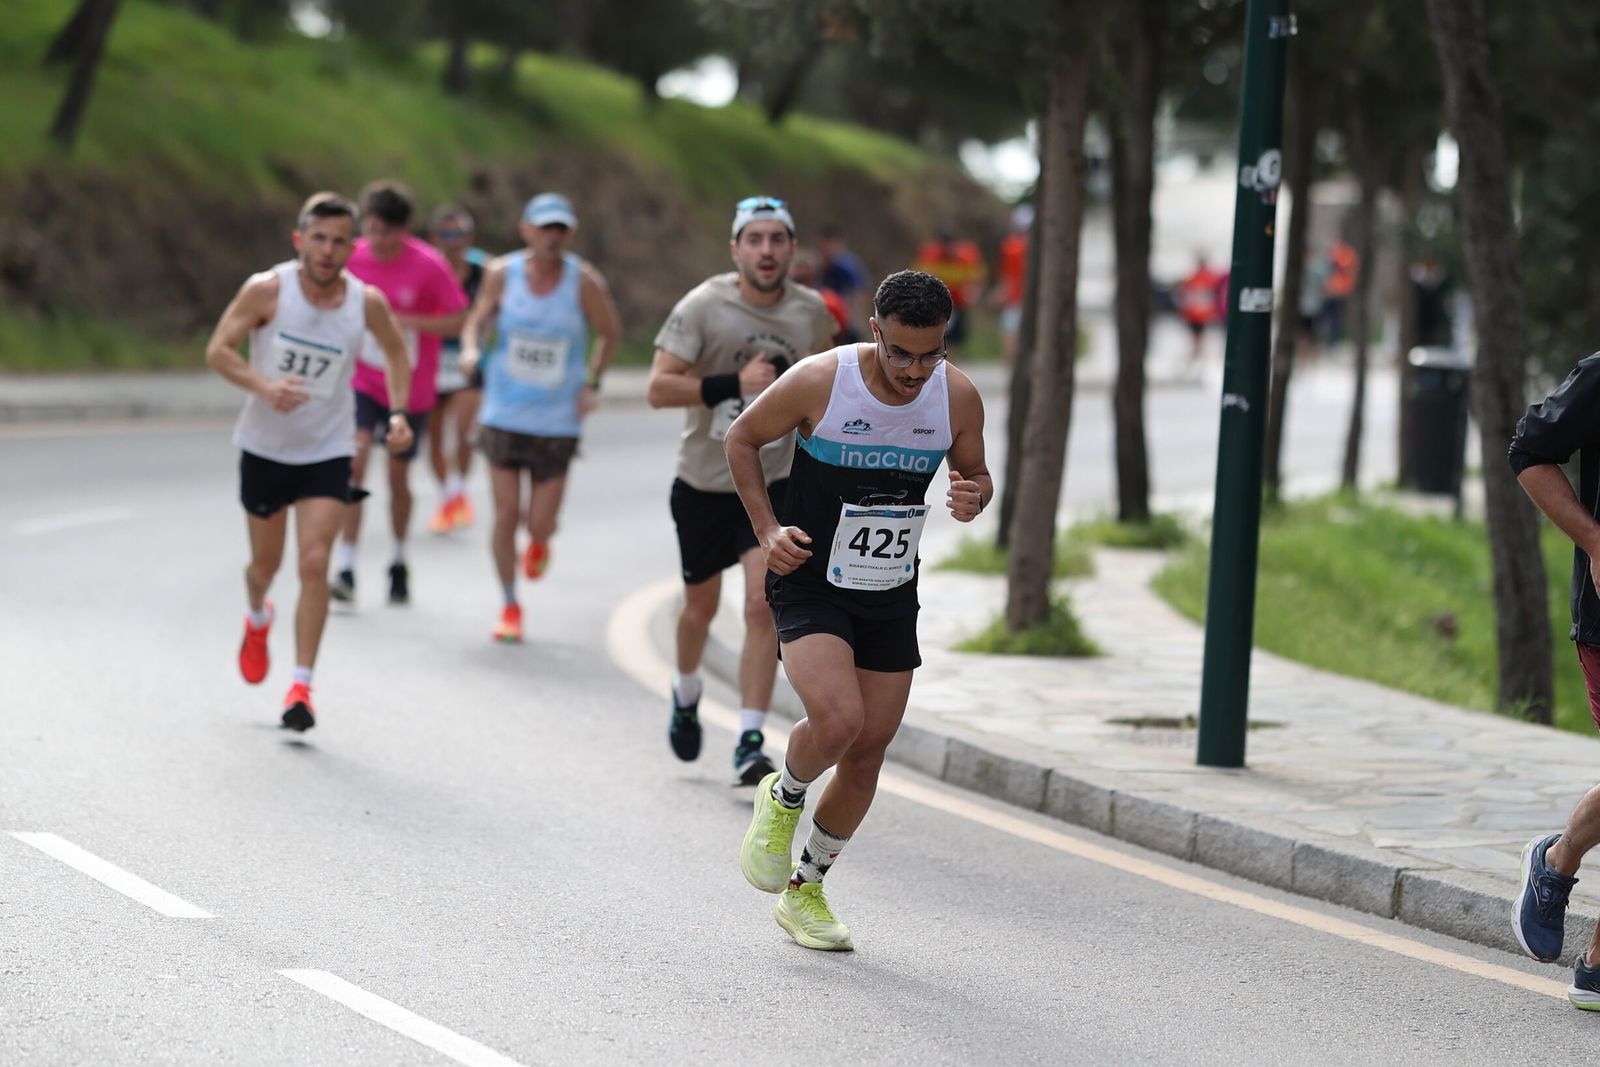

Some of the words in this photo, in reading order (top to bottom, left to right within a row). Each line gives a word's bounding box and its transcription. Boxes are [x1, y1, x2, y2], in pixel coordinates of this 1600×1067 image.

[278, 350, 331, 379] 317
[841, 445, 930, 471] inacua
[848, 527, 911, 559] 425
